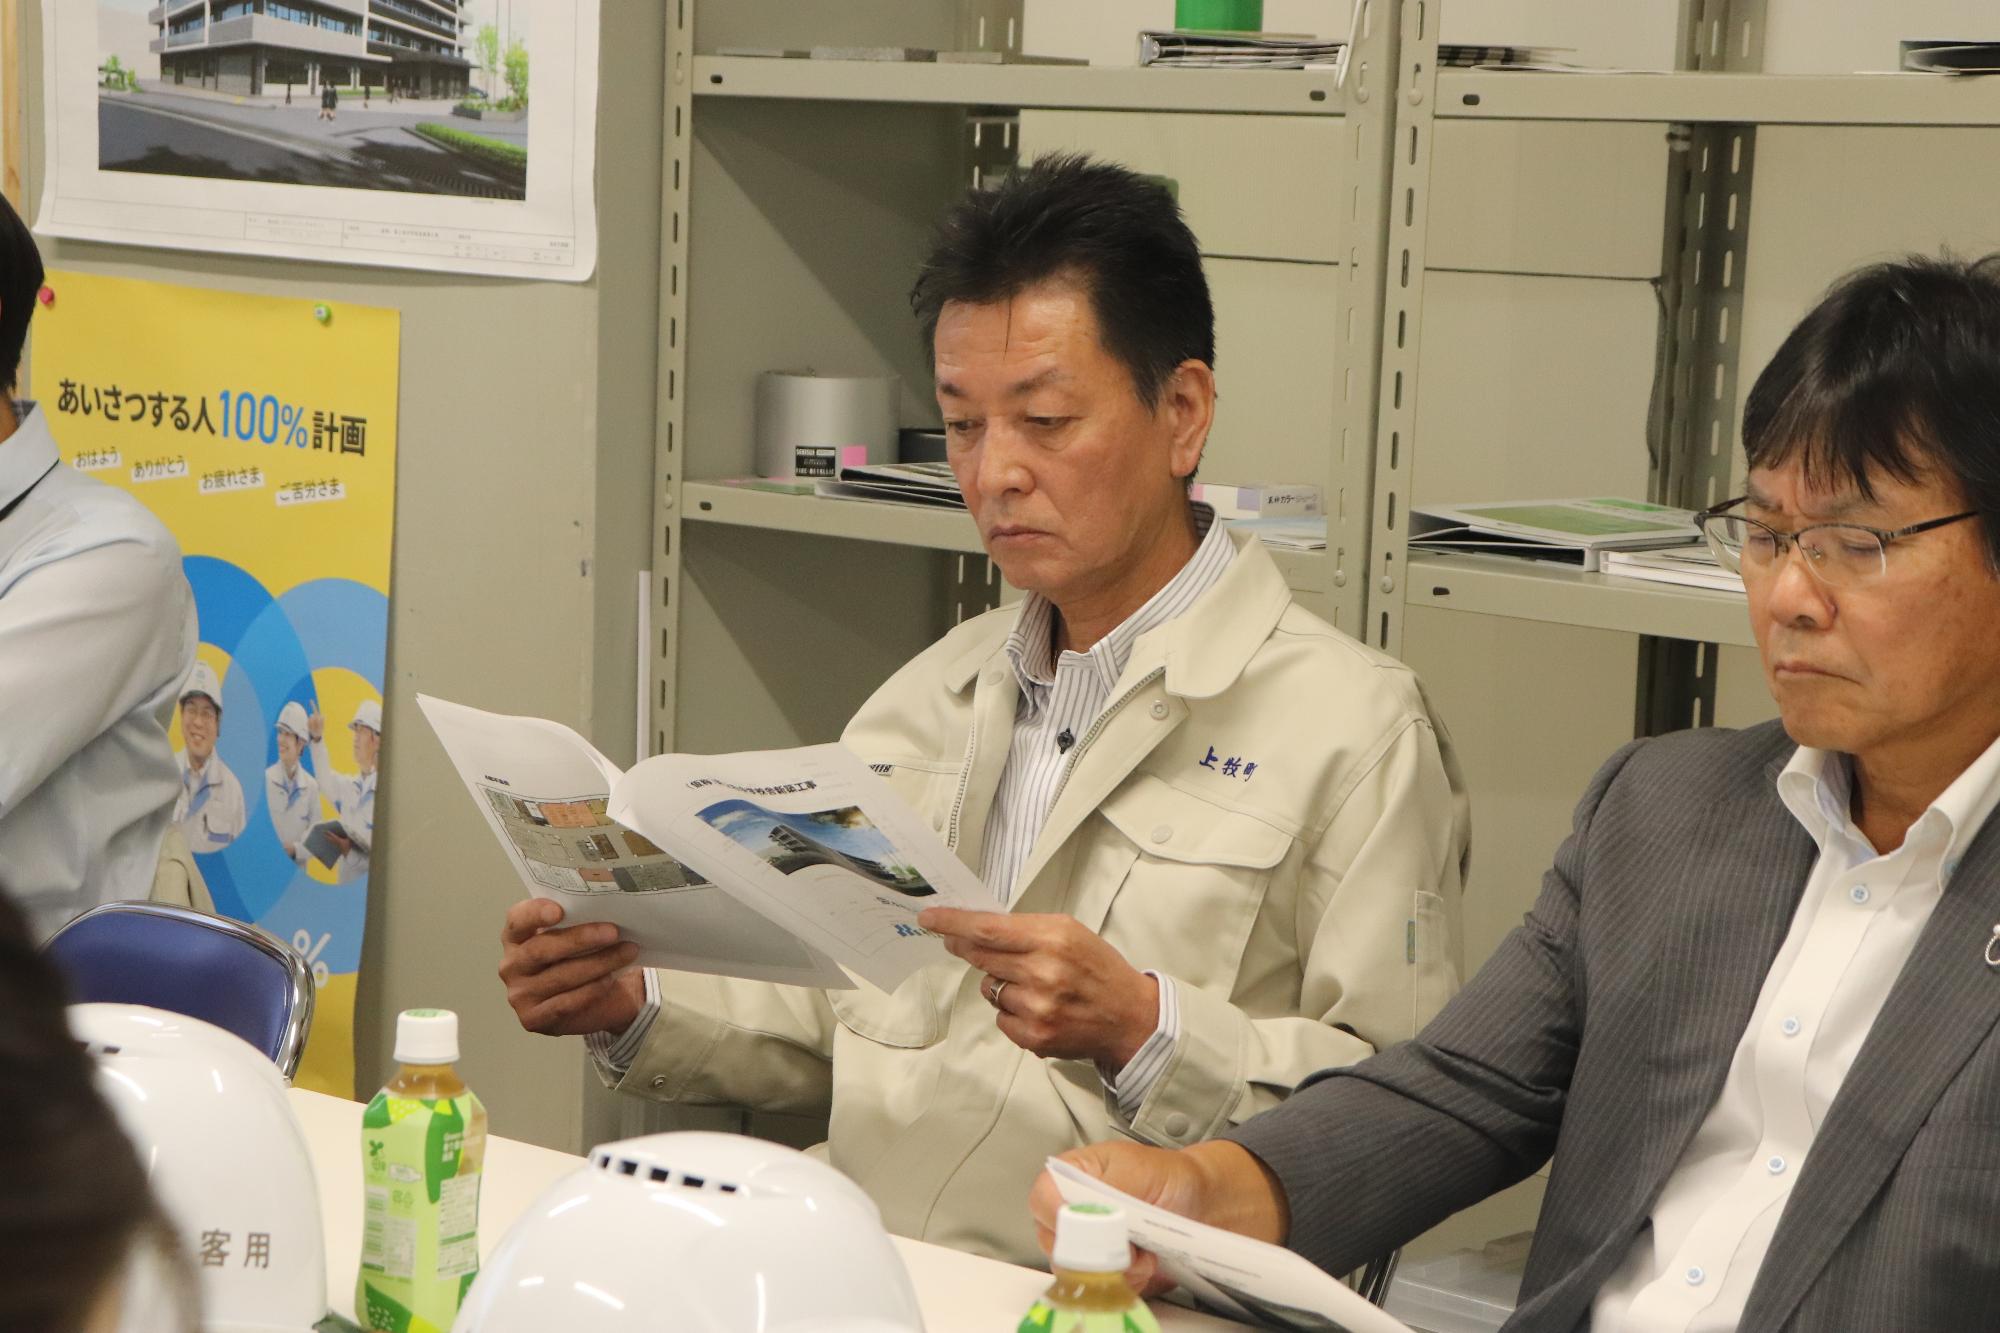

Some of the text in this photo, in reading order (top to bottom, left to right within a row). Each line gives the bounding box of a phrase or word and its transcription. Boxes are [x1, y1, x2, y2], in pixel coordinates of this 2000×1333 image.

[57, 378, 367, 457] あいさつする人100%計画
[75, 446, 118, 469] おはよう
[133, 455, 186, 479] ありがとう
[202, 466, 261, 490] お疲れさま
[1199, 745, 1258, 782] 上牧町
